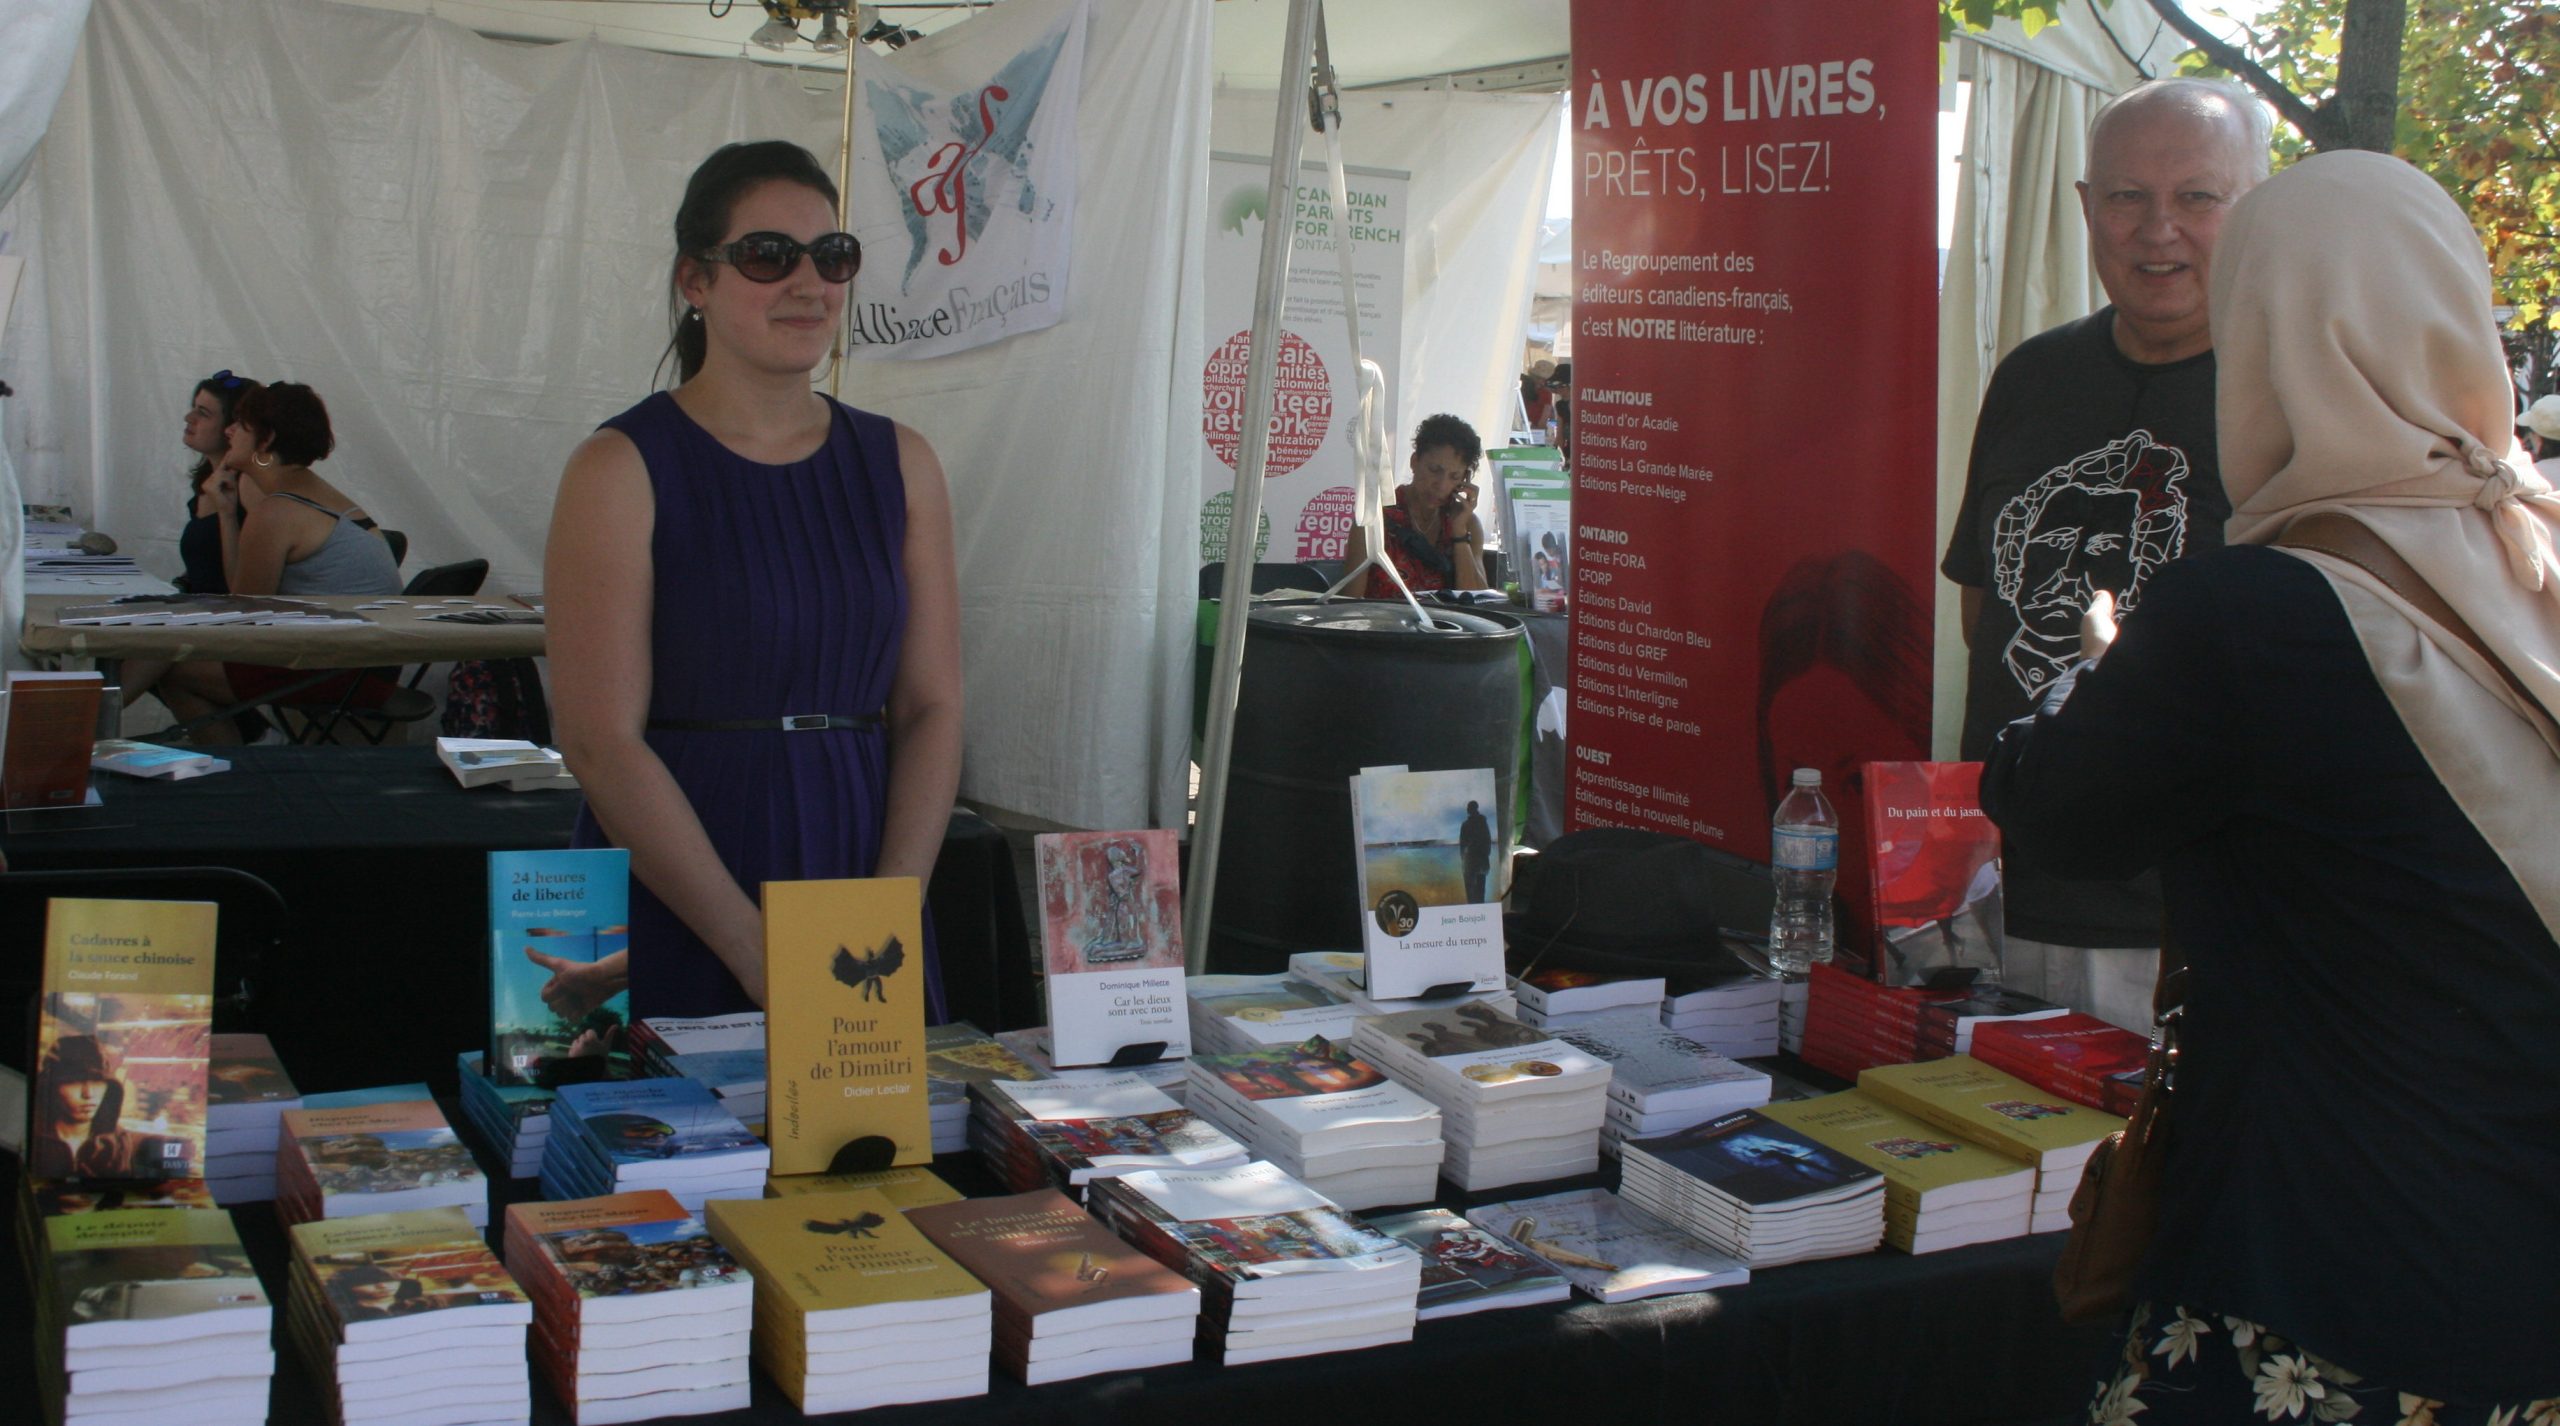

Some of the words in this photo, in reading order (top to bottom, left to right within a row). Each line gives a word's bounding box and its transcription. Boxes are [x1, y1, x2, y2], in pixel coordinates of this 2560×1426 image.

[1584, 69, 1610, 130] À
[1621, 73, 1708, 127] VOS
[1723, 58, 1886, 122] LIVRES,
[1585, 136, 1706, 202] PRÊTS,
[1722, 140, 1831, 194] LISEZ!
[1296, 186, 1387, 208] CANDIAN
[1296, 203, 1373, 224] PARTS
[1295, 221, 1328, 236] FOR
[1334, 225, 1400, 243] RENCH
[1582, 250, 1598, 270] Le
[1601, 250, 1719, 276] Regroupement
[1724, 251, 1754, 272] des
[1582, 284, 1643, 304] éditeurs
[1648, 285, 1794, 315] canadiens-français,
[1582, 317, 1613, 337] c'est
[1617, 318, 1676, 340] NOTRE
[1679, 321, 1756, 345] littérature
[1581, 388, 1653, 406] ATLANTIQUE
[1581, 410, 1614, 426] Bouton
[1617, 413, 1639, 428] d'or
[1642, 415, 1679, 432] Acadie
[1581, 431, 1617, 449] Éditions
[1620, 435, 1647, 451] Karo
[1580, 452, 1617, 471] Éditions
[1620, 458, 1633, 472] La
[1637, 460, 1676, 477] Grande
[1679, 464, 1713, 482] Marée
[1580, 472, 1617, 492] Éditions
[1620, 480, 1687, 504] Perce-Neige
[1579, 525, 1628, 545] ONTARIO
[1579, 547, 1610, 565] Centre
[1613, 552, 1646, 570] FORA
[1578, 568, 1612, 586] CFORP
[1578, 586, 1616, 609] Éditions
[1619, 599, 1651, 615] David
[1578, 610, 1616, 631] Éditions
[1619, 619, 1633, 634] du
[1636, 622, 1684, 643] Chardon
[1686, 631, 1712, 648] Bleu
[1578, 631, 1616, 652] Éditions
[1618, 640, 1633, 655] du
[1636, 643, 1668, 662] GREF
[1577, 653, 1615, 674] Éditions
[1618, 662, 1632, 677] du
[1636, 665, 1688, 689] Vermillon
[1577, 674, 1615, 696] Éditions
[1618, 683, 1680, 709] L'Interligne
[1577, 695, 1615, 717] Éditions
[1618, 706, 1646, 724] Prise
[1648, 712, 1663, 728] de
[1666, 717, 1701, 737] parole
[1576, 745, 1612, 766] OUEST
[1576, 766, 1650, 799] Apprentissage
[1652, 785, 1690, 808] Illimité
[1575, 786, 1613, 810] Éditions
[1615, 799, 1630, 814] de
[1631, 803, 1641, 818] la
[1644, 809, 1691, 830] nouvelle
[1693, 820, 1725, 841] plume
[1888, 807, 1903, 818] Du
[1906, 807, 1928, 820] pain
[1931, 809, 1941, 818] et
[1944, 806, 1957, 818] du
[1960, 807, 1986, 820] jasm
[512, 871, 530, 885] 24
[535, 871, 587, 884] heures
[512, 889, 530, 902] de
[535, 888, 585, 902] liberté
[1400, 918, 1414, 929] 30
[1441, 916, 1456, 926] Jean
[69, 933, 138, 947] Cadavres
[142, 934, 152, 947] à
[1400, 941, 1410, 950] La
[1413, 940, 1442, 950] mesure
[1446, 937, 1457, 947] du
[1460, 938, 1487, 949] temps
[88, 952, 129, 964] sauce
[133, 952, 196, 966] chinoise
[1100, 981, 1140, 991] Dominique
[1143, 979, 1170, 989] Millette
[1108, 1007, 1127, 1017] sont
[1130, 1007, 1148, 1016] avec
[1151, 1006, 1172, 1015] nous
[1114, 996, 1131, 1007] Car
[1133, 996, 1145, 1006] les
[1148, 995, 1171, 1006] dieux
[833, 1016, 878, 1034] Pour
[827, 1039, 902, 1057] l'amour
[810, 1062, 833, 1080] de
[840, 1058, 912, 1079] Dimitri
[844, 1083, 874, 1097] Didier
[877, 1083, 911, 1096] Leclair
